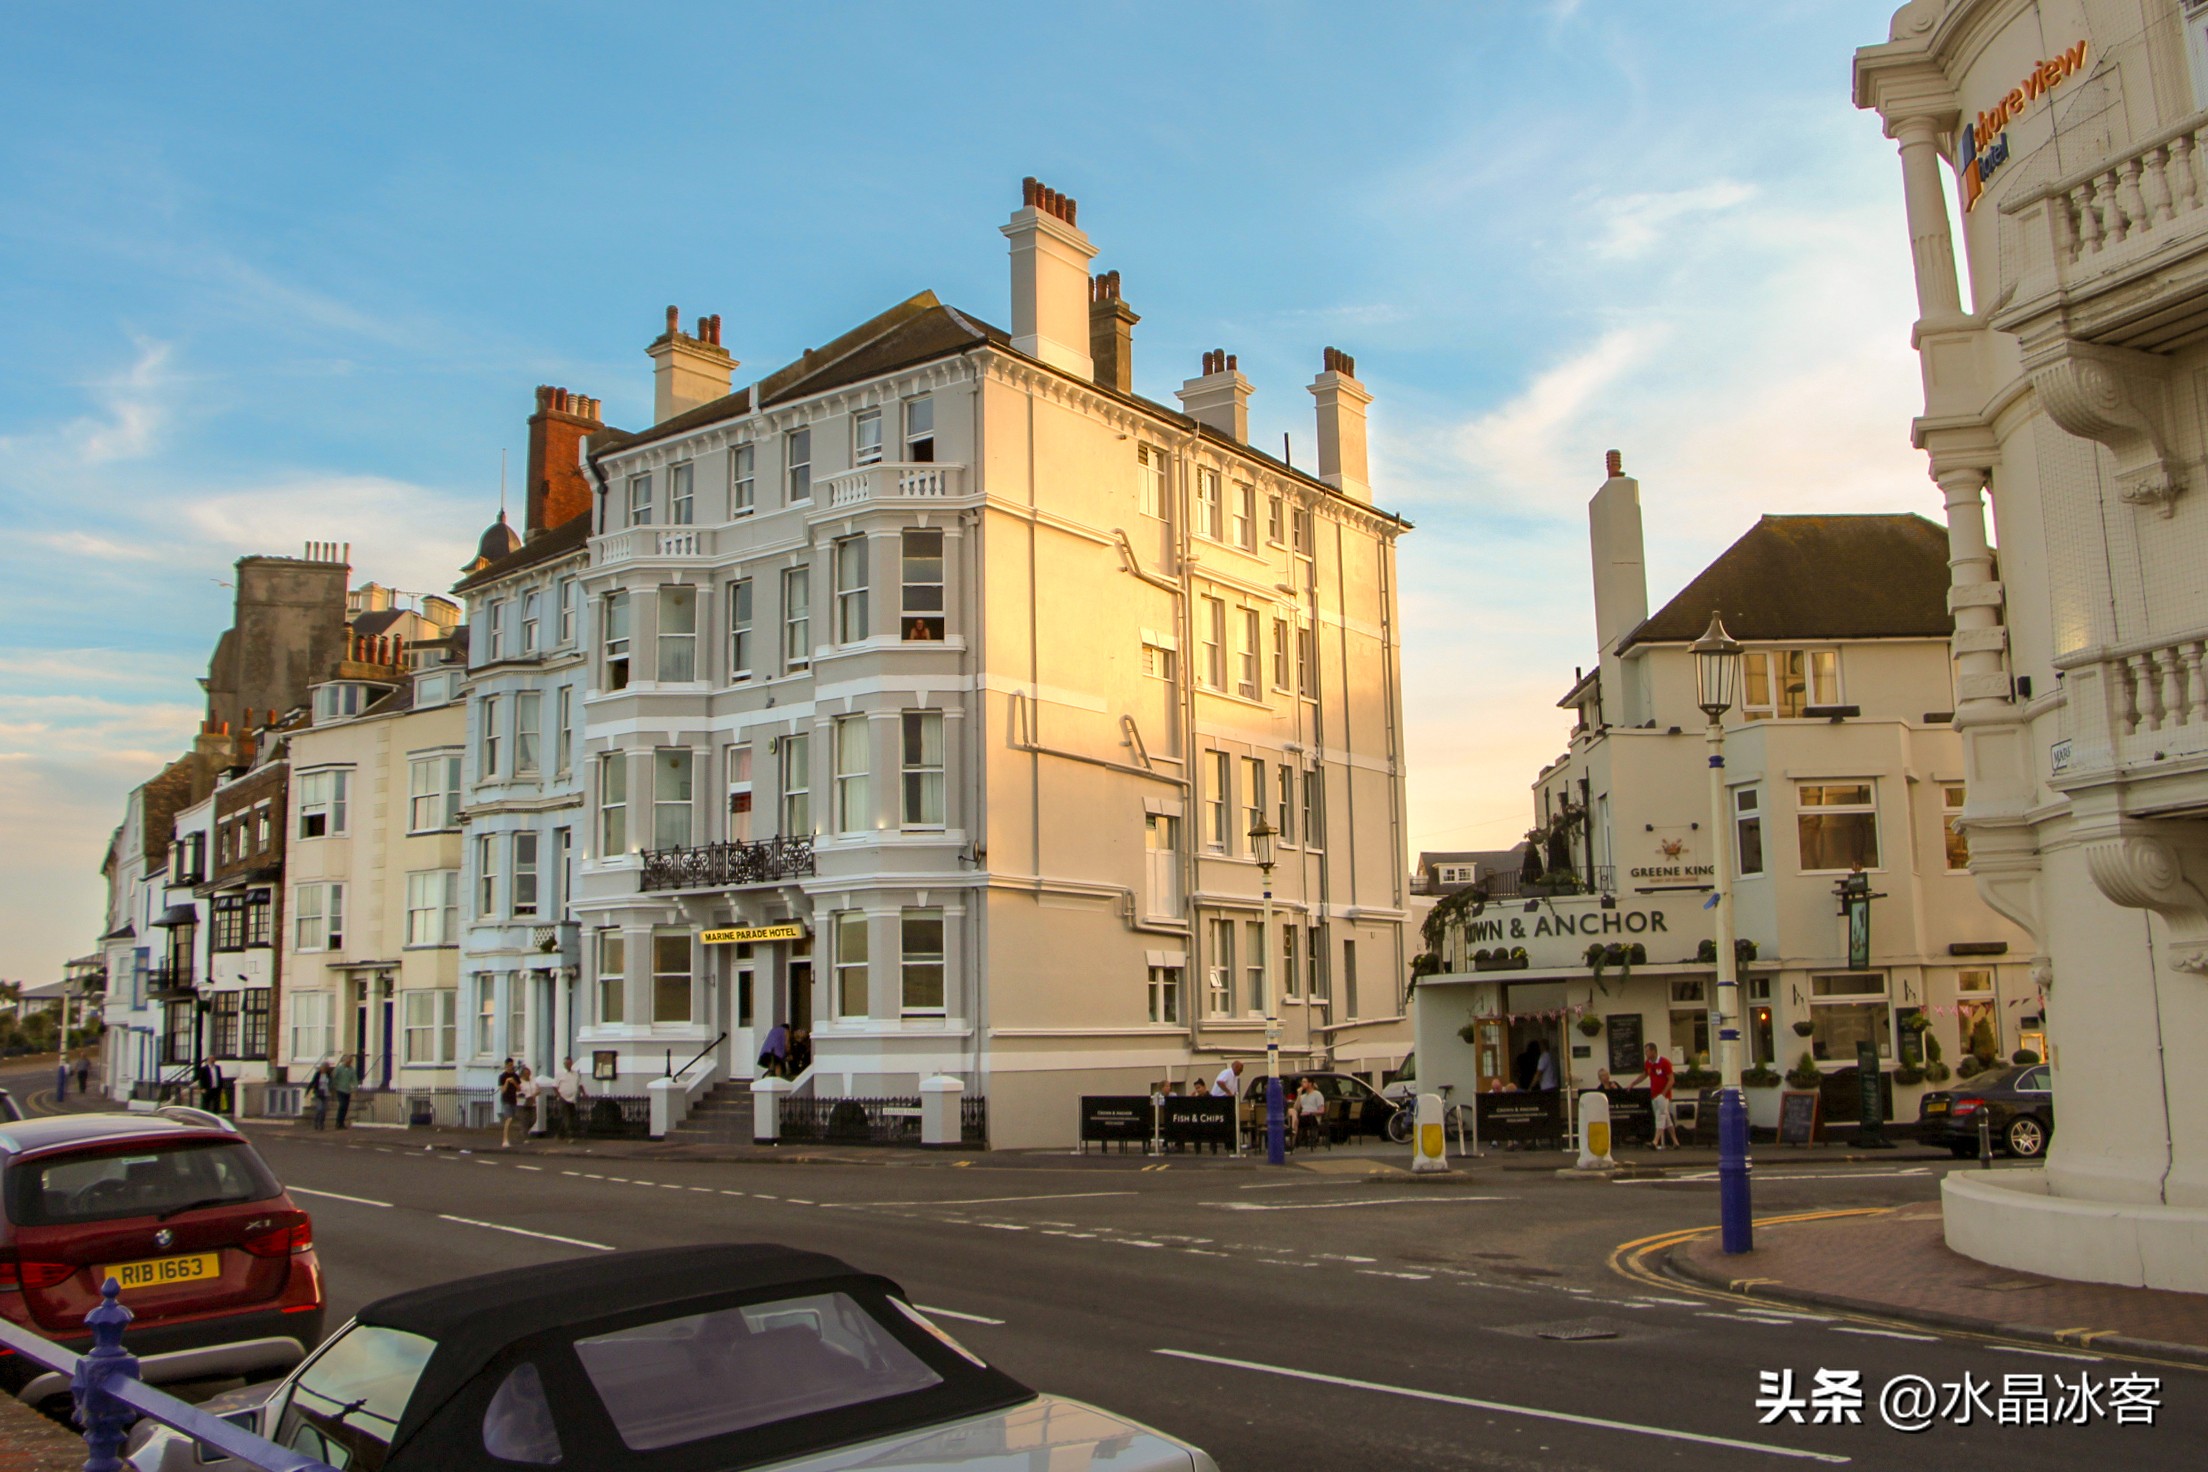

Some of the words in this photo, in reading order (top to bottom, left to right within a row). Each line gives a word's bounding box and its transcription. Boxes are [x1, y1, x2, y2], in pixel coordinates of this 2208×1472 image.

[1630, 866, 1680, 877] GREENE
[1510, 917, 1526, 939] &
[1534, 910, 1668, 937] ANCHOR
[705, 931, 735, 941] MARINE
[736, 929, 767, 940] PARADE
[768, 927, 797, 938] HOTEL
[1191, 1113, 1198, 1123] &
[121, 1263, 154, 1285] RIB
[159, 1257, 203, 1280] 1663
